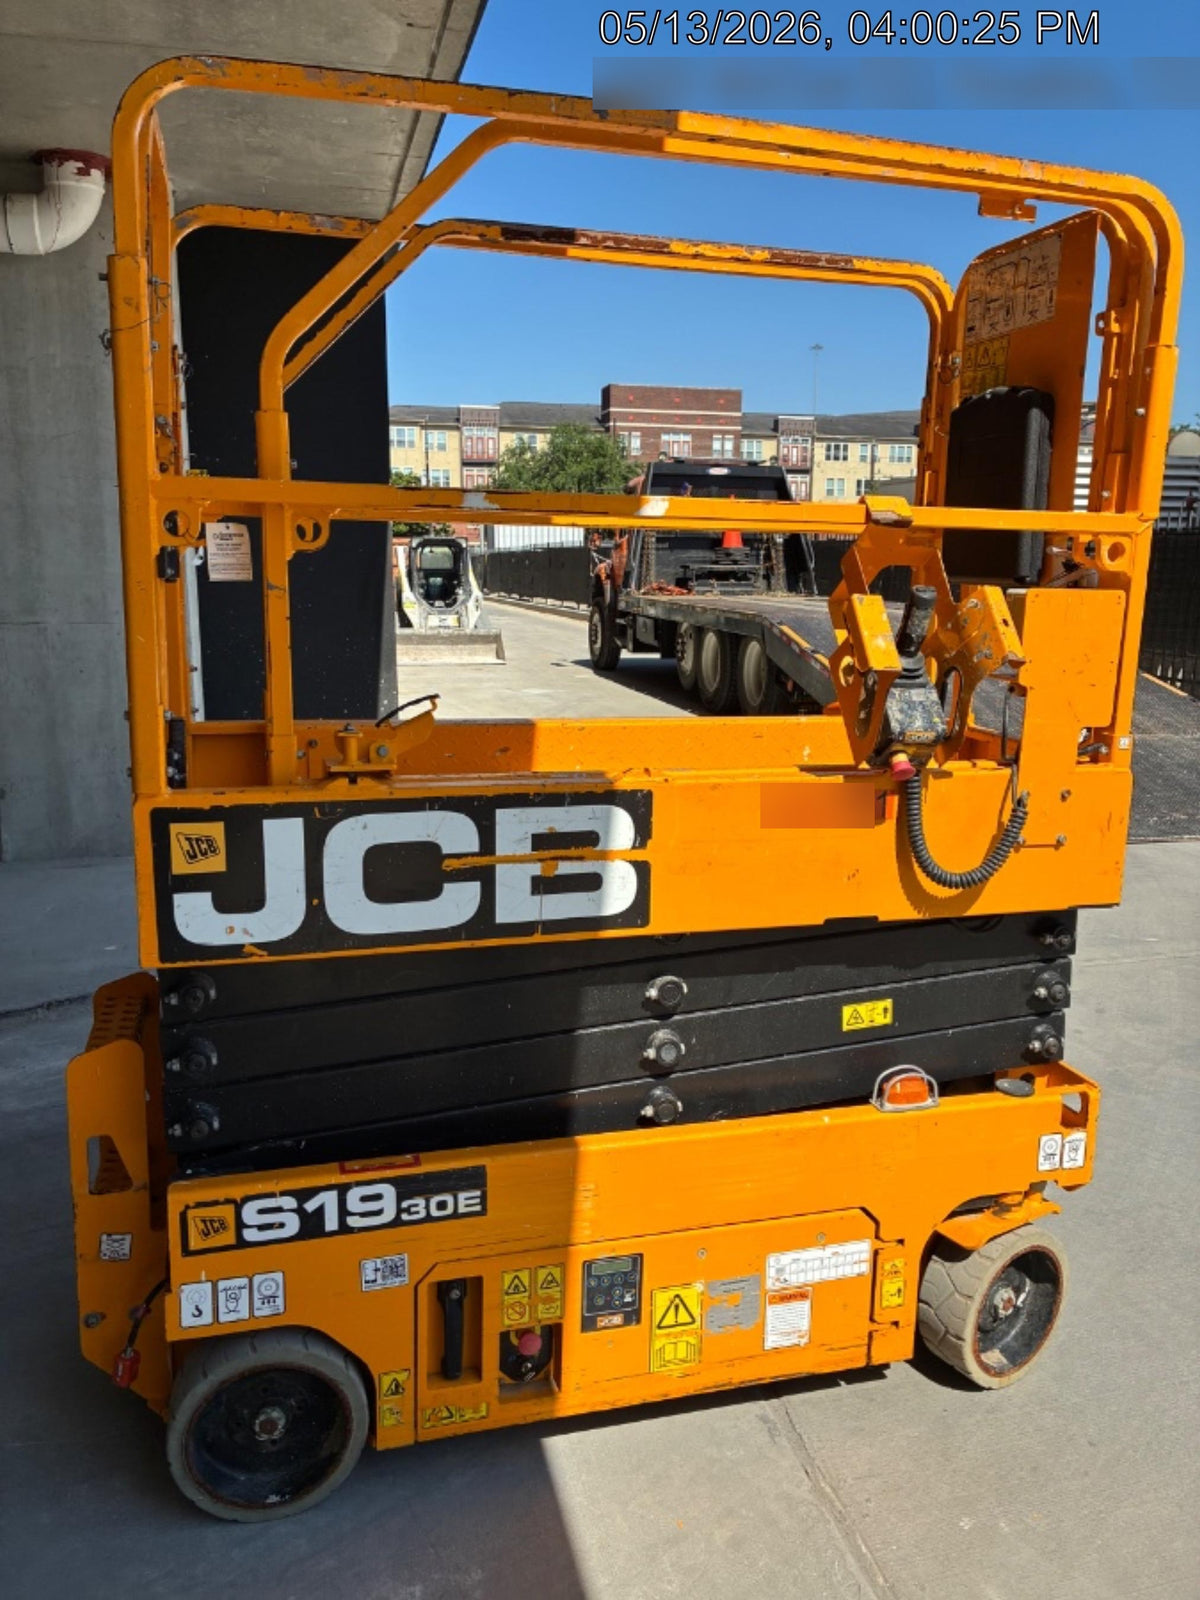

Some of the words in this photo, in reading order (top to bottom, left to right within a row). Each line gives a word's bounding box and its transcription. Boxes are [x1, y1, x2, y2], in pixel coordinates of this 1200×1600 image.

[183, 836, 218, 860] JCB
[172, 804, 638, 946] JCB
[200, 1218, 228, 1238] JCB
